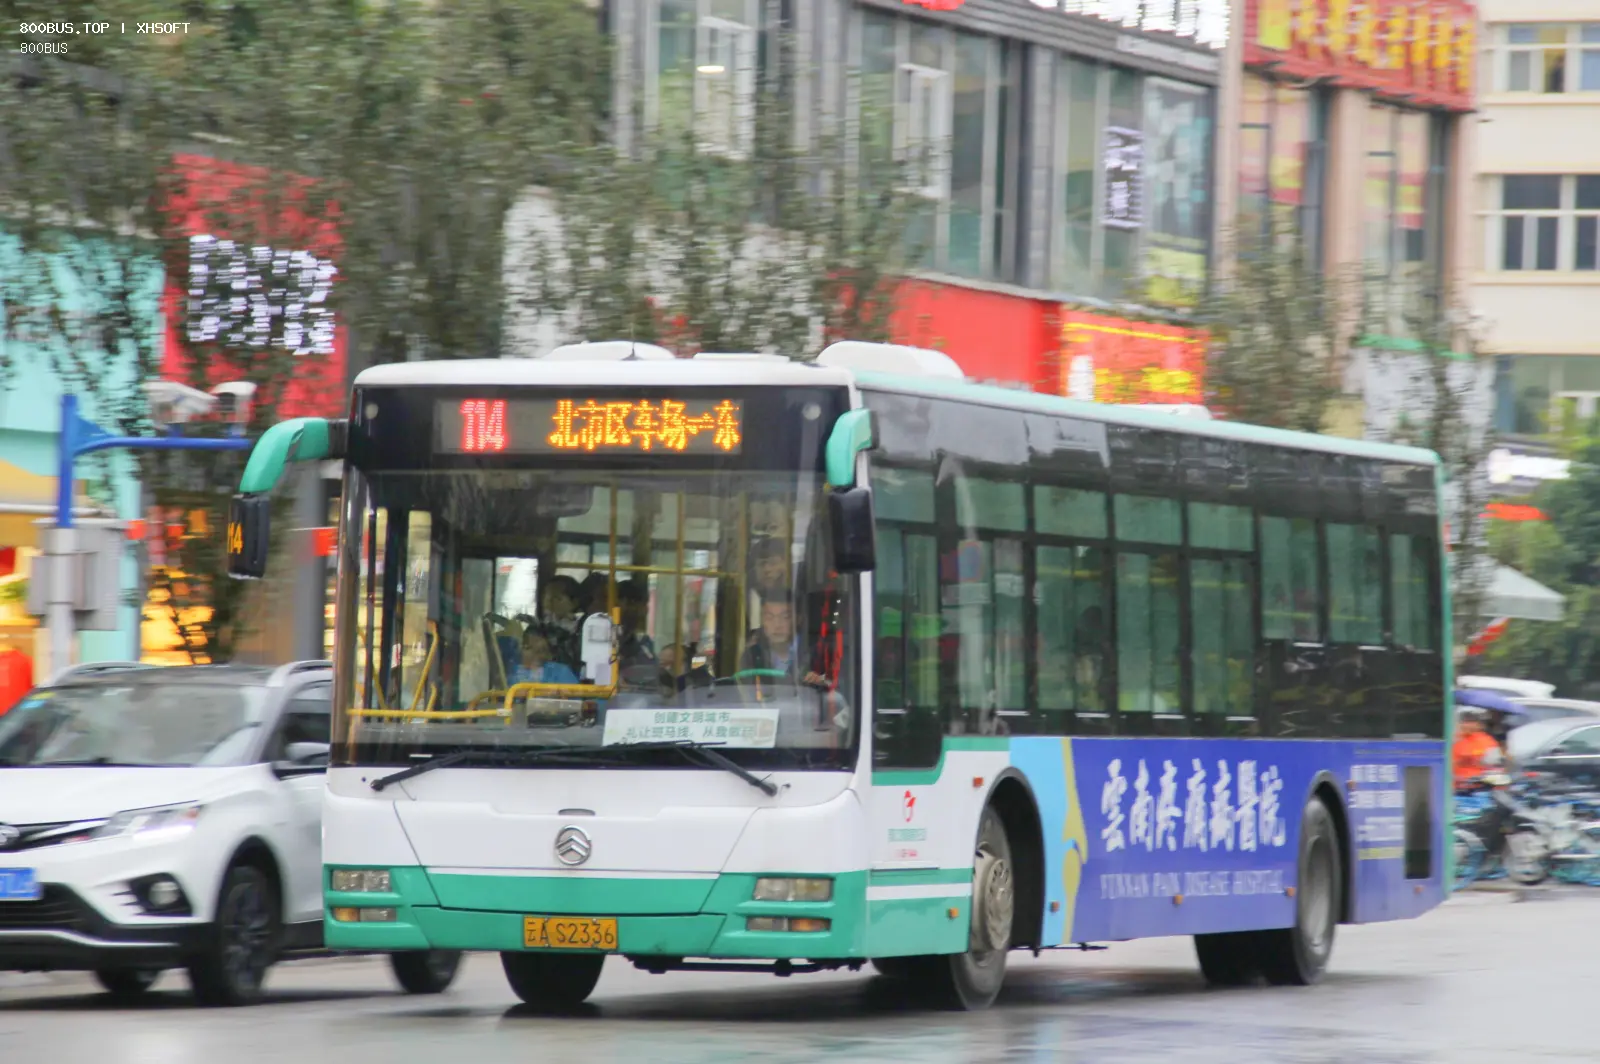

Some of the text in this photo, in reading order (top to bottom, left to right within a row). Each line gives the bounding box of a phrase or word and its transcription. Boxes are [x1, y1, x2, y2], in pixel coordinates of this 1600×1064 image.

[460, 399, 508, 451] 114
[655, 711, 731, 723] 创建文明城市
